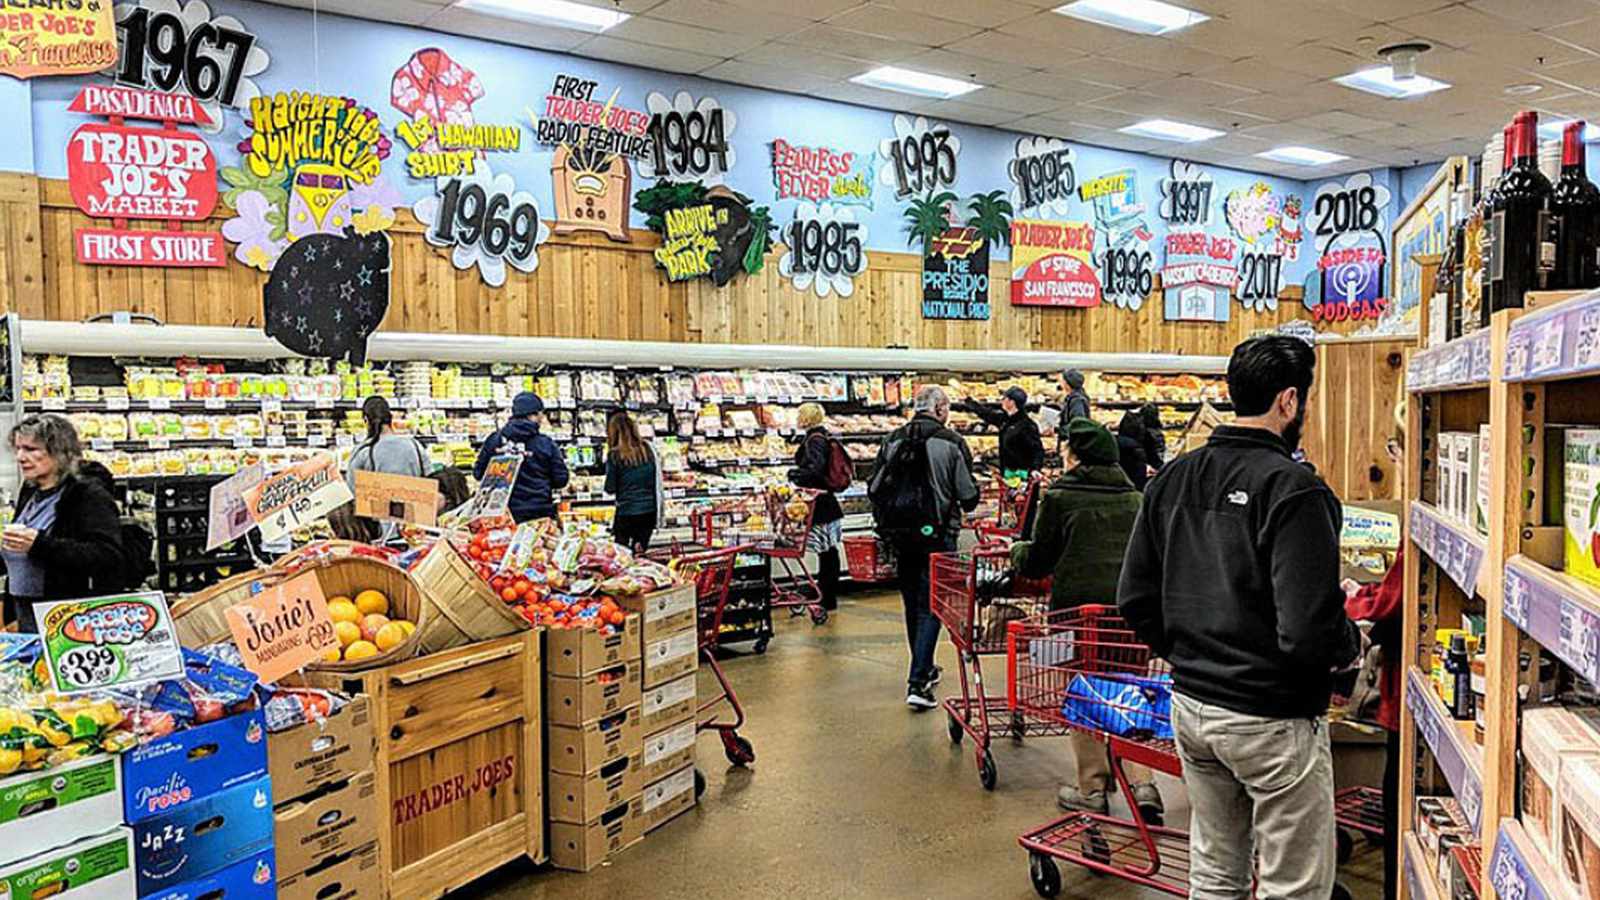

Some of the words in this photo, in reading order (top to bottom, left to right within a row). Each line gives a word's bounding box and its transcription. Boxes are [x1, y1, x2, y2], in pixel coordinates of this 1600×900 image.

[38, 13, 96, 36] JOE'S
[117, 8, 255, 107] 1967
[553, 75, 598, 101] FIRST
[545, 95, 604, 124] TRADER
[605, 107, 650, 137] JOE'S
[75, 132, 207, 171] TRADER
[248, 119, 337, 178] SUMMER
[437, 123, 521, 151] HAWAIIAN
[537, 120, 581, 145] RADIO
[587, 127, 654, 159] FEATURE
[647, 108, 729, 176] 1984
[407, 151, 475, 177] SHIRT
[773, 138, 853, 176] FEARLESS
[891, 129, 956, 197] 1993
[101, 163, 190, 199] JOE'S
[778, 169, 830, 202] FLYER
[1017, 148, 1075, 208] 1995
[89, 196, 199, 218] MARKET
[1169, 180, 1213, 223] 1997
[1315, 187, 1378, 236] 2018
[435, 179, 538, 260] 1969
[665, 205, 717, 238] ARRIVE
[1011, 221, 1062, 248] TRADER
[1063, 223, 1096, 252] JOE'S
[82, 234, 145, 262] FIRST
[150, 236, 217, 263] STORE
[668, 247, 711, 282] PARK
[790, 220, 862, 276] 1985
[923, 271, 988, 292] PRESIDIO
[944, 260, 970, 275] THE
[1104, 249, 1152, 296] 1996
[1243, 254, 1282, 299] 2017
[1024, 281, 1045, 297] SAN
[1046, 281, 1096, 298] FRANCISCO
[4, 781, 40, 802] organic
[148, 786, 193, 813] rose
[392, 774, 466, 826] TRADER
[141, 824, 187, 851] JAZZ
[17, 863, 54, 888] organic
